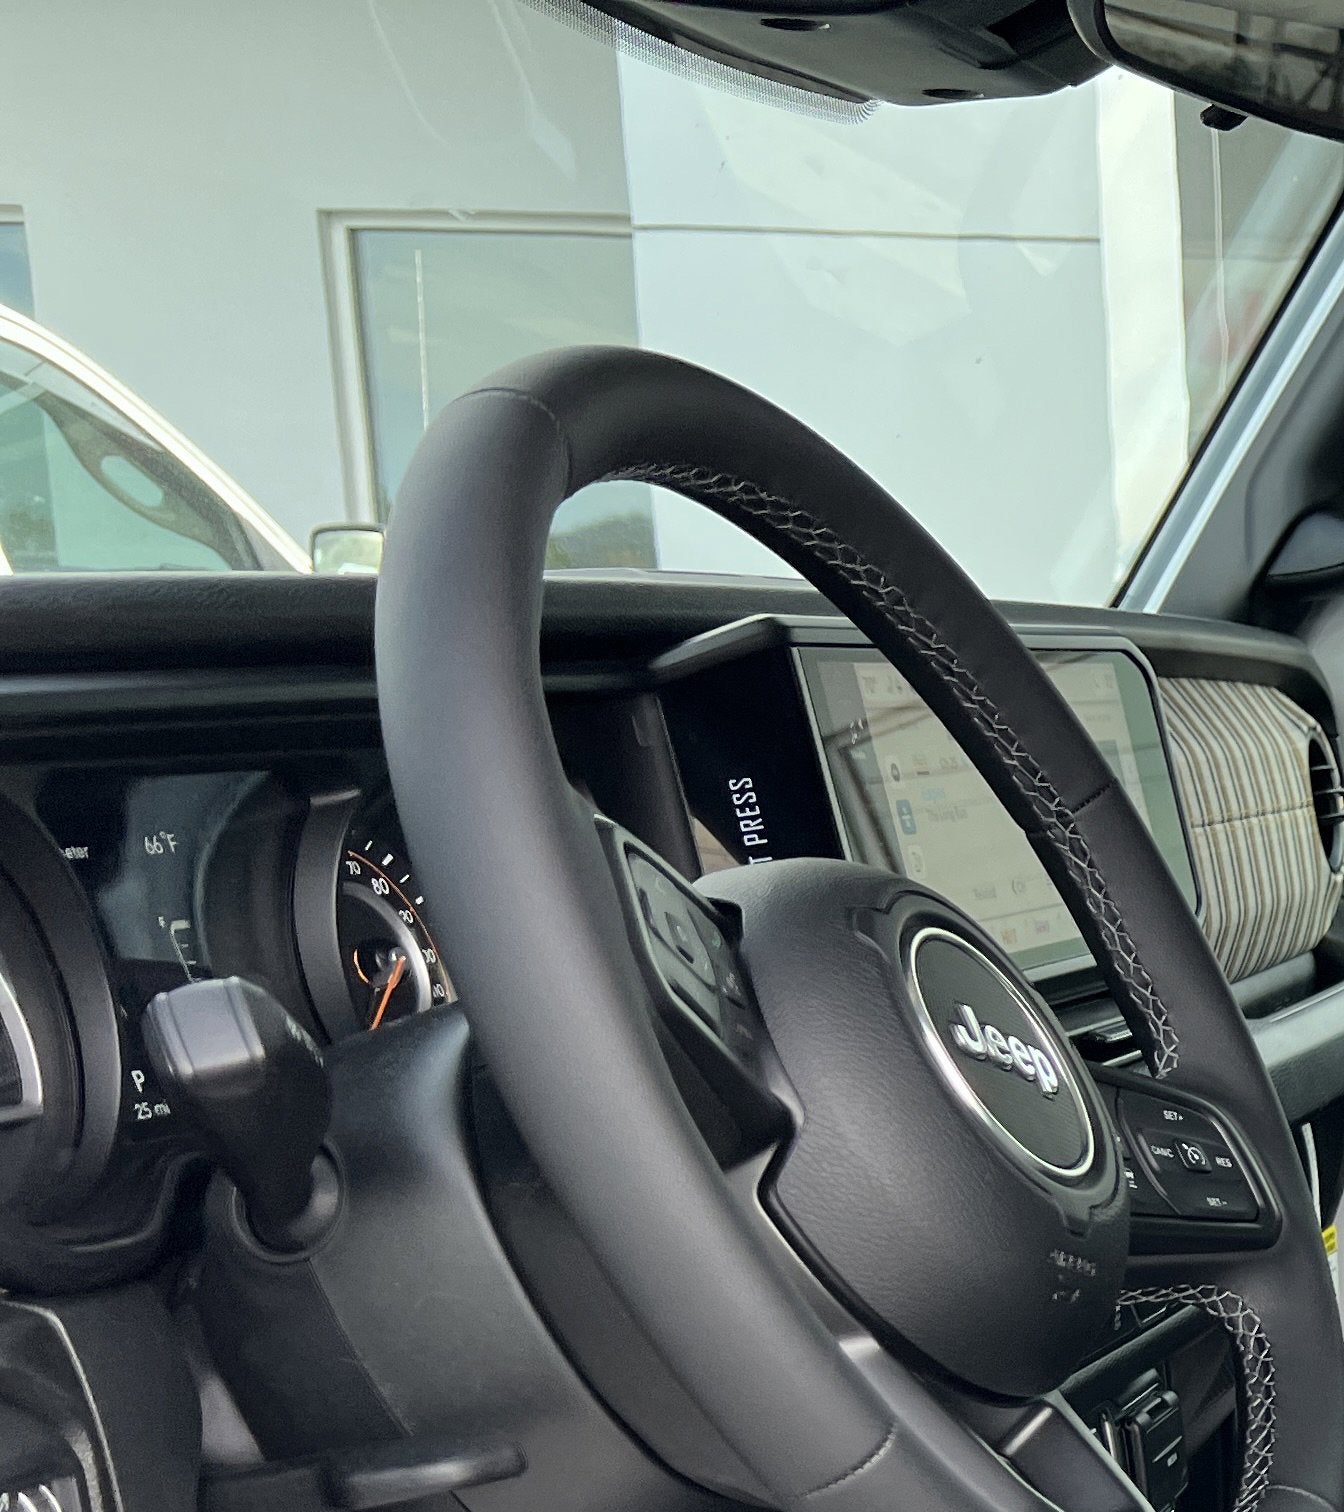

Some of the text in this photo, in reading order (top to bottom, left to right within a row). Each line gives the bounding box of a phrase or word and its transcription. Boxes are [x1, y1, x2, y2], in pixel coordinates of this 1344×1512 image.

[728, 777, 768, 846] PRESS
[371, 877, 390, 895] 80
[951, 1002, 1059, 1097] Jeep
[131, 1070, 146, 1094] P
[134, 1102, 152, 1121] 25
